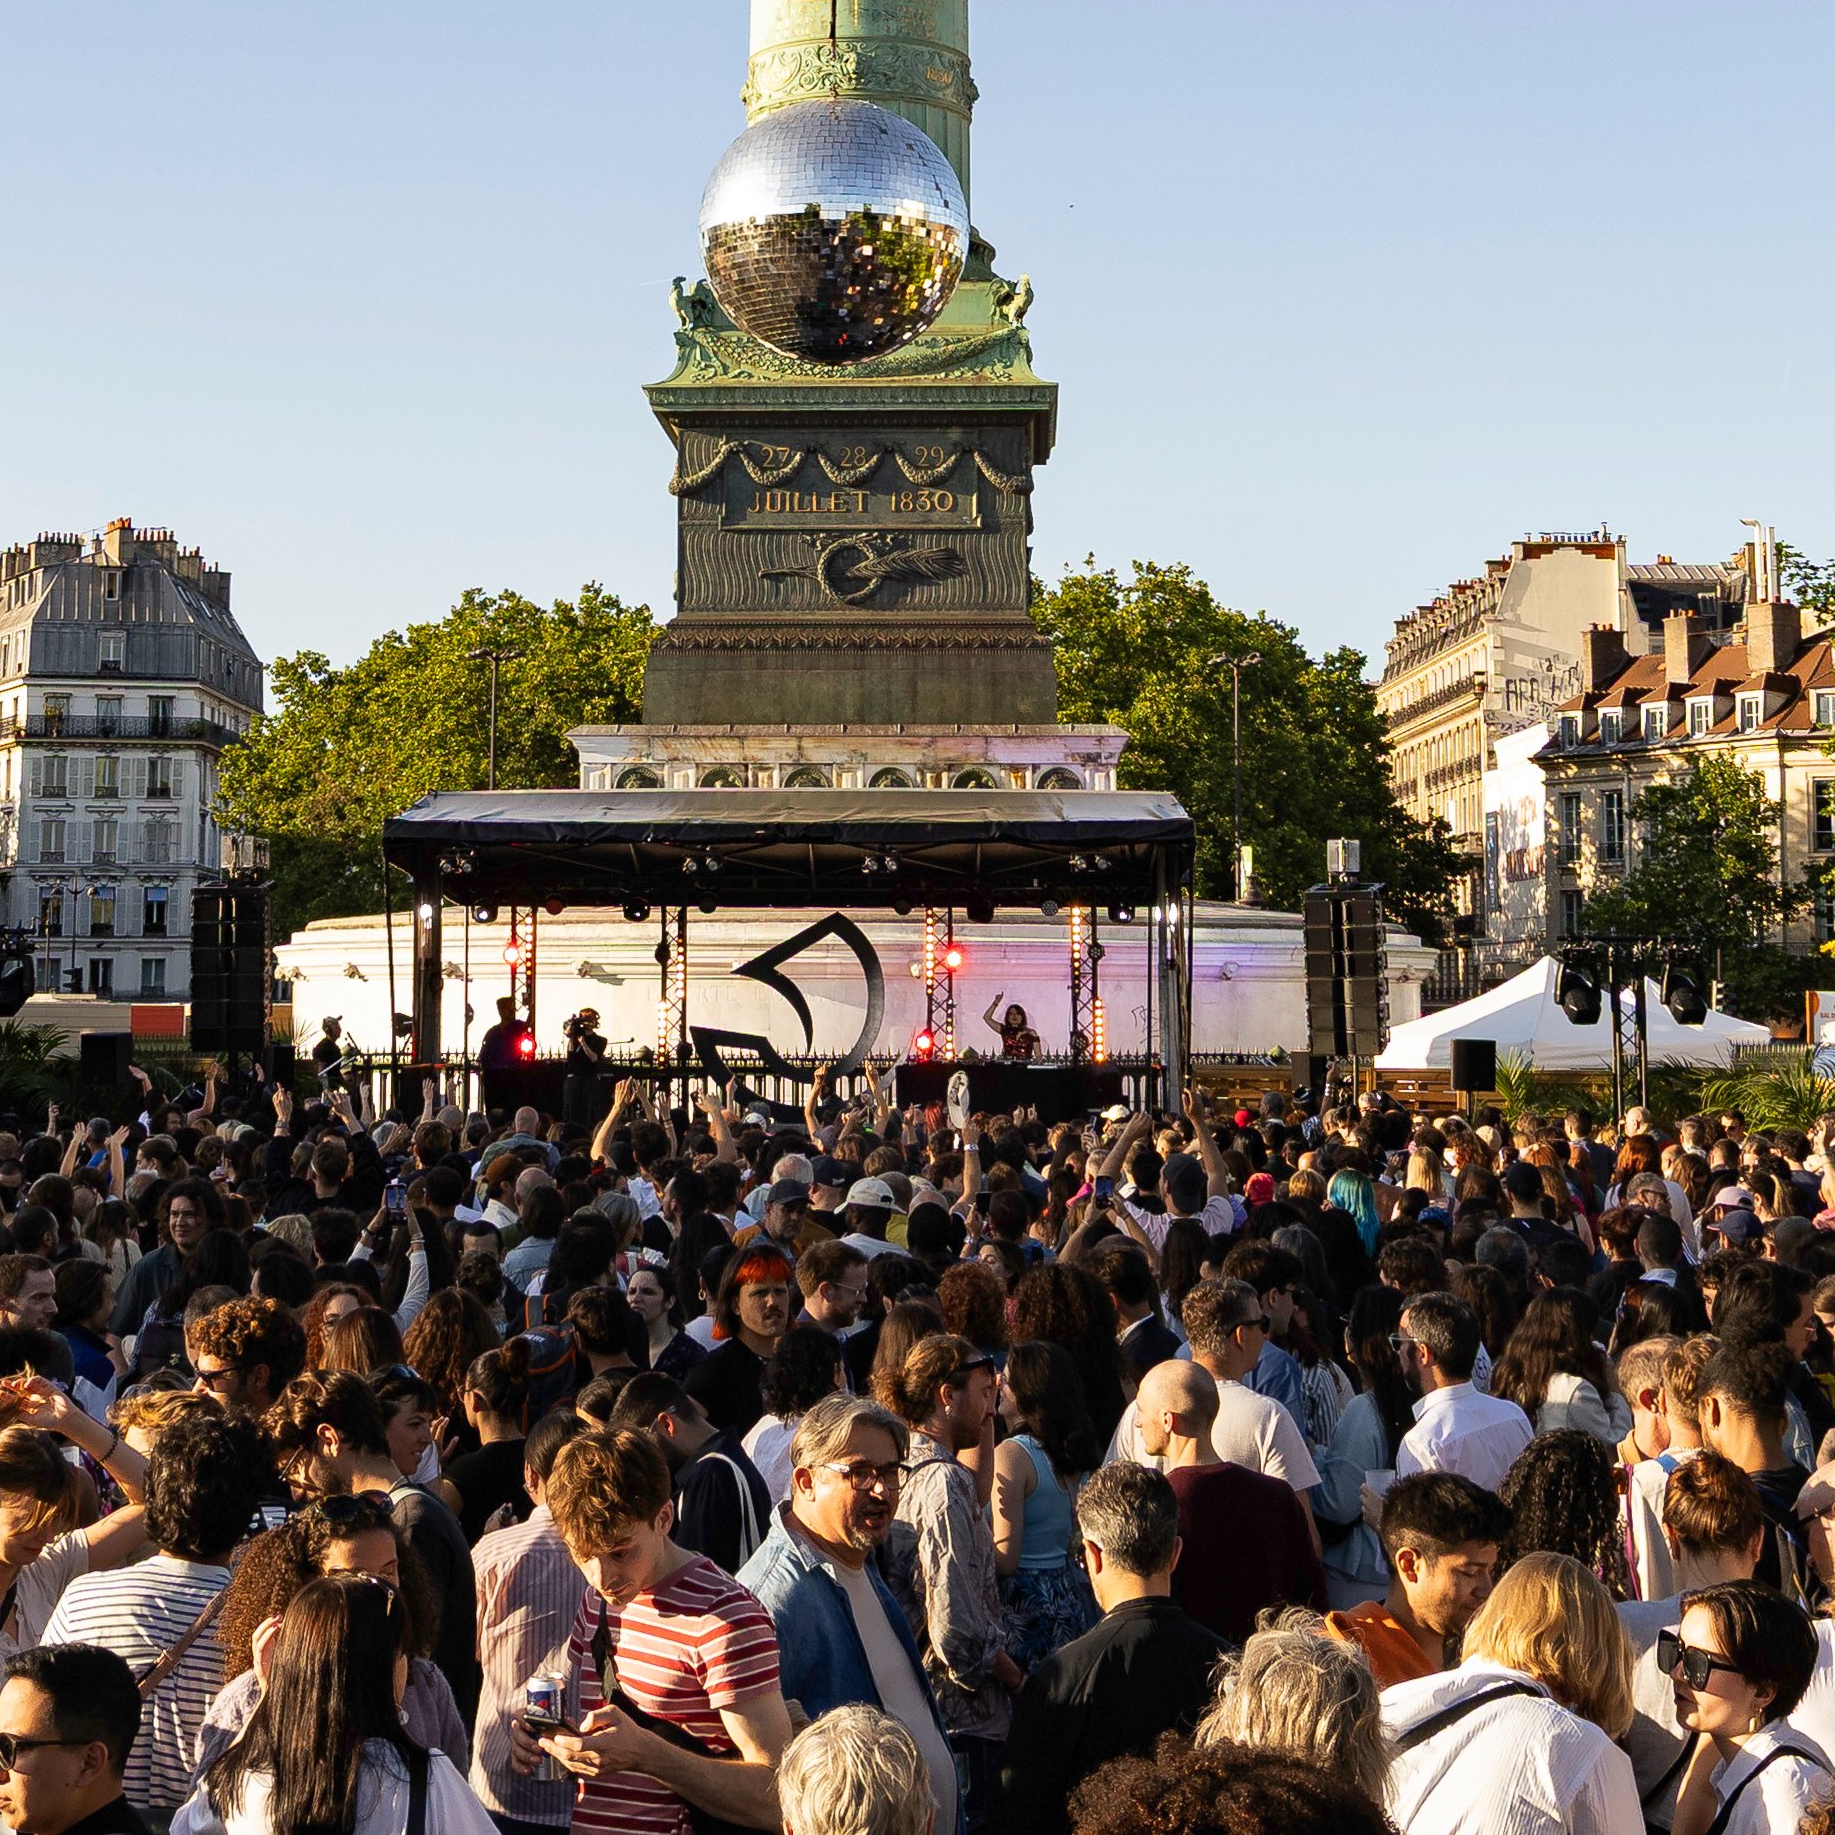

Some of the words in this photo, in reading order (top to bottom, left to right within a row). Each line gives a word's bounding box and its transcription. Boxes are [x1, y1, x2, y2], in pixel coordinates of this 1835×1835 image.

[761, 447, 790, 467] 27
[839, 446, 867, 467] 28
[915, 446, 944, 467] 29
[748, 490, 870, 513] JUILLET
[890, 490, 953, 513] 1830
